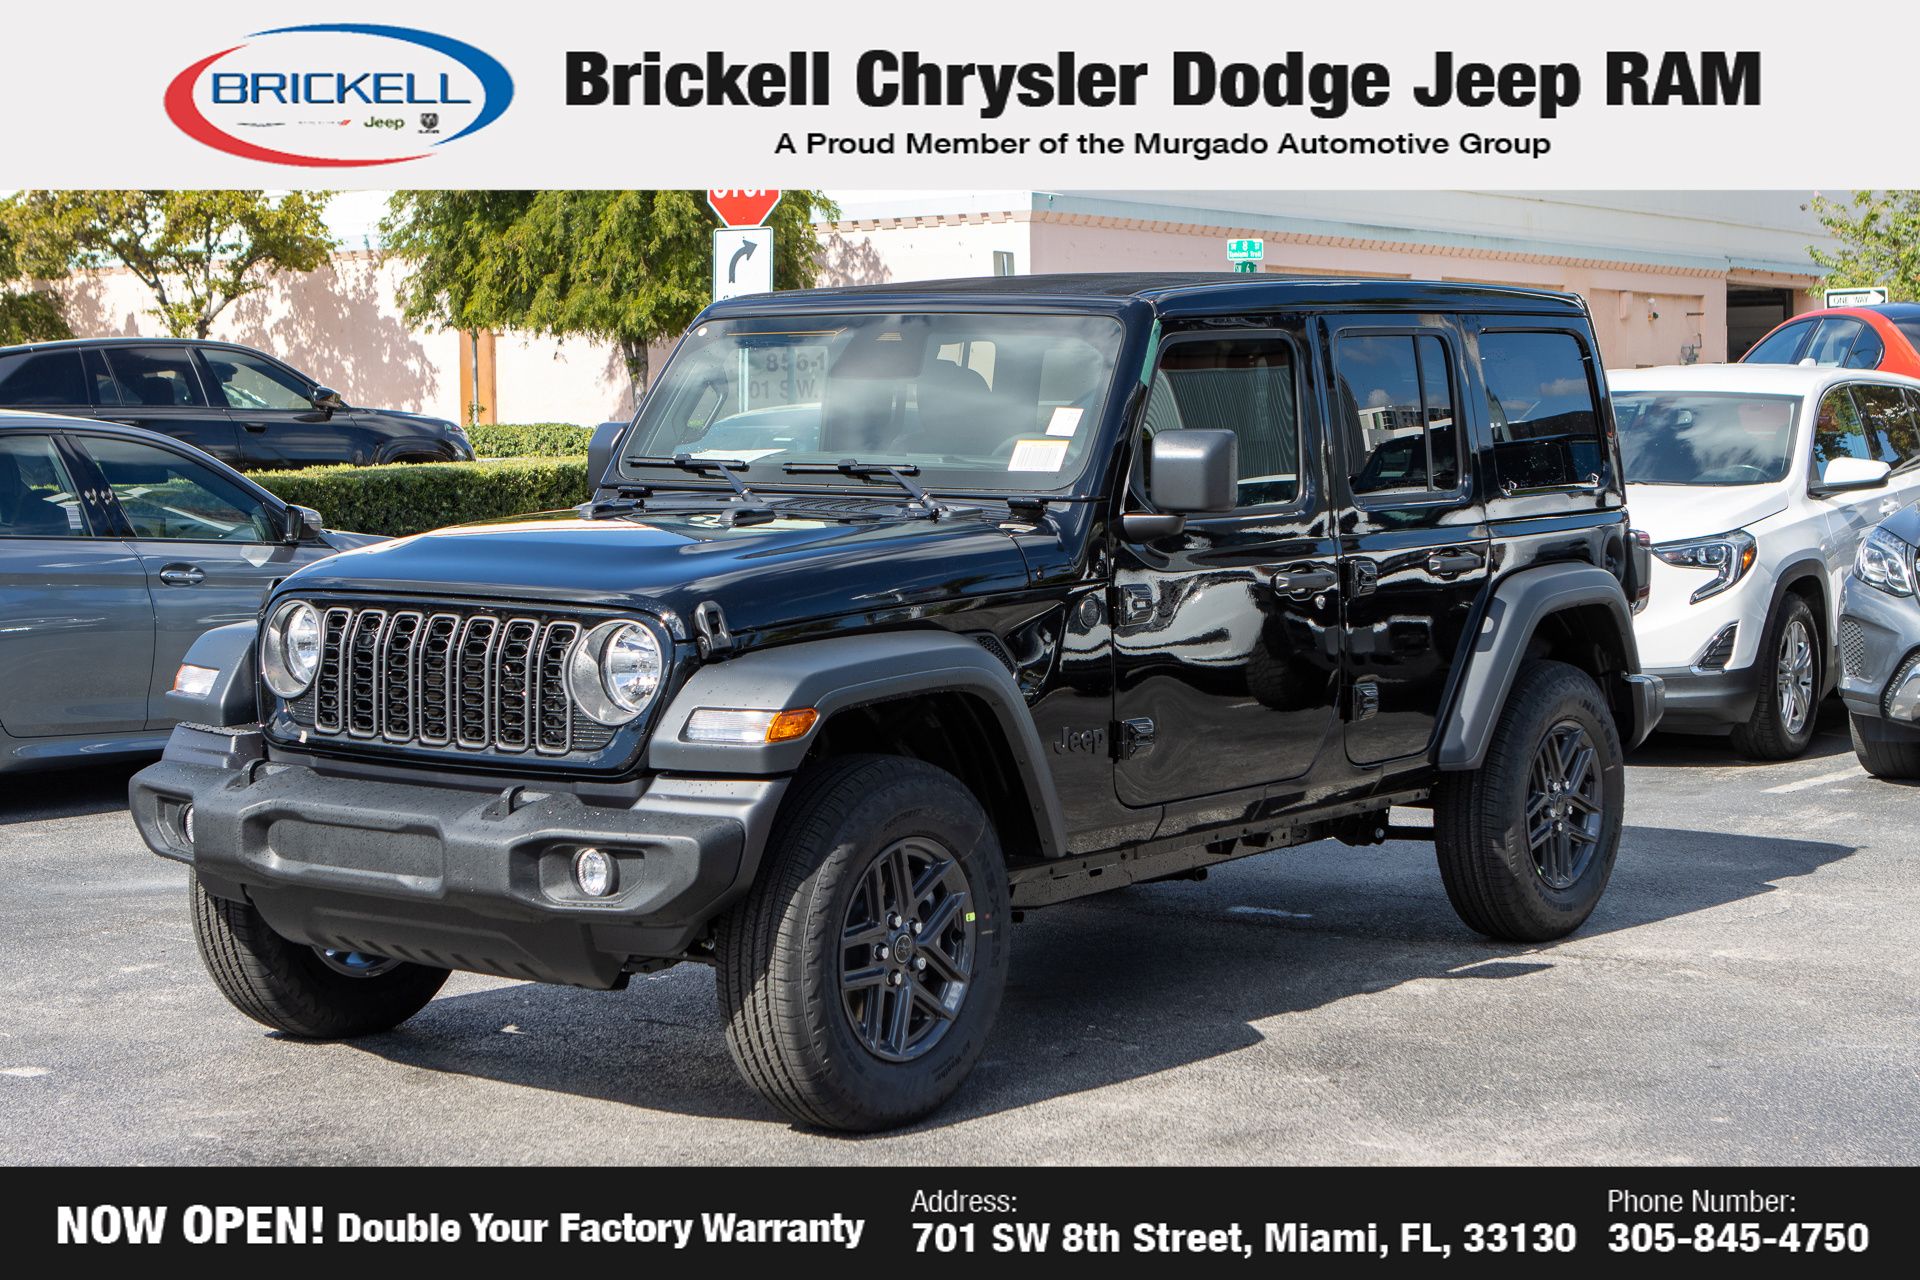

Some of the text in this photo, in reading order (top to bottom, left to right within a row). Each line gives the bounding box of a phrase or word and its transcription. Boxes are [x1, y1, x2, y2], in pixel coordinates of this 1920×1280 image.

[1833, 294, 1869, 304] ONE WAY
[1053, 726, 1104, 754] Jeep
